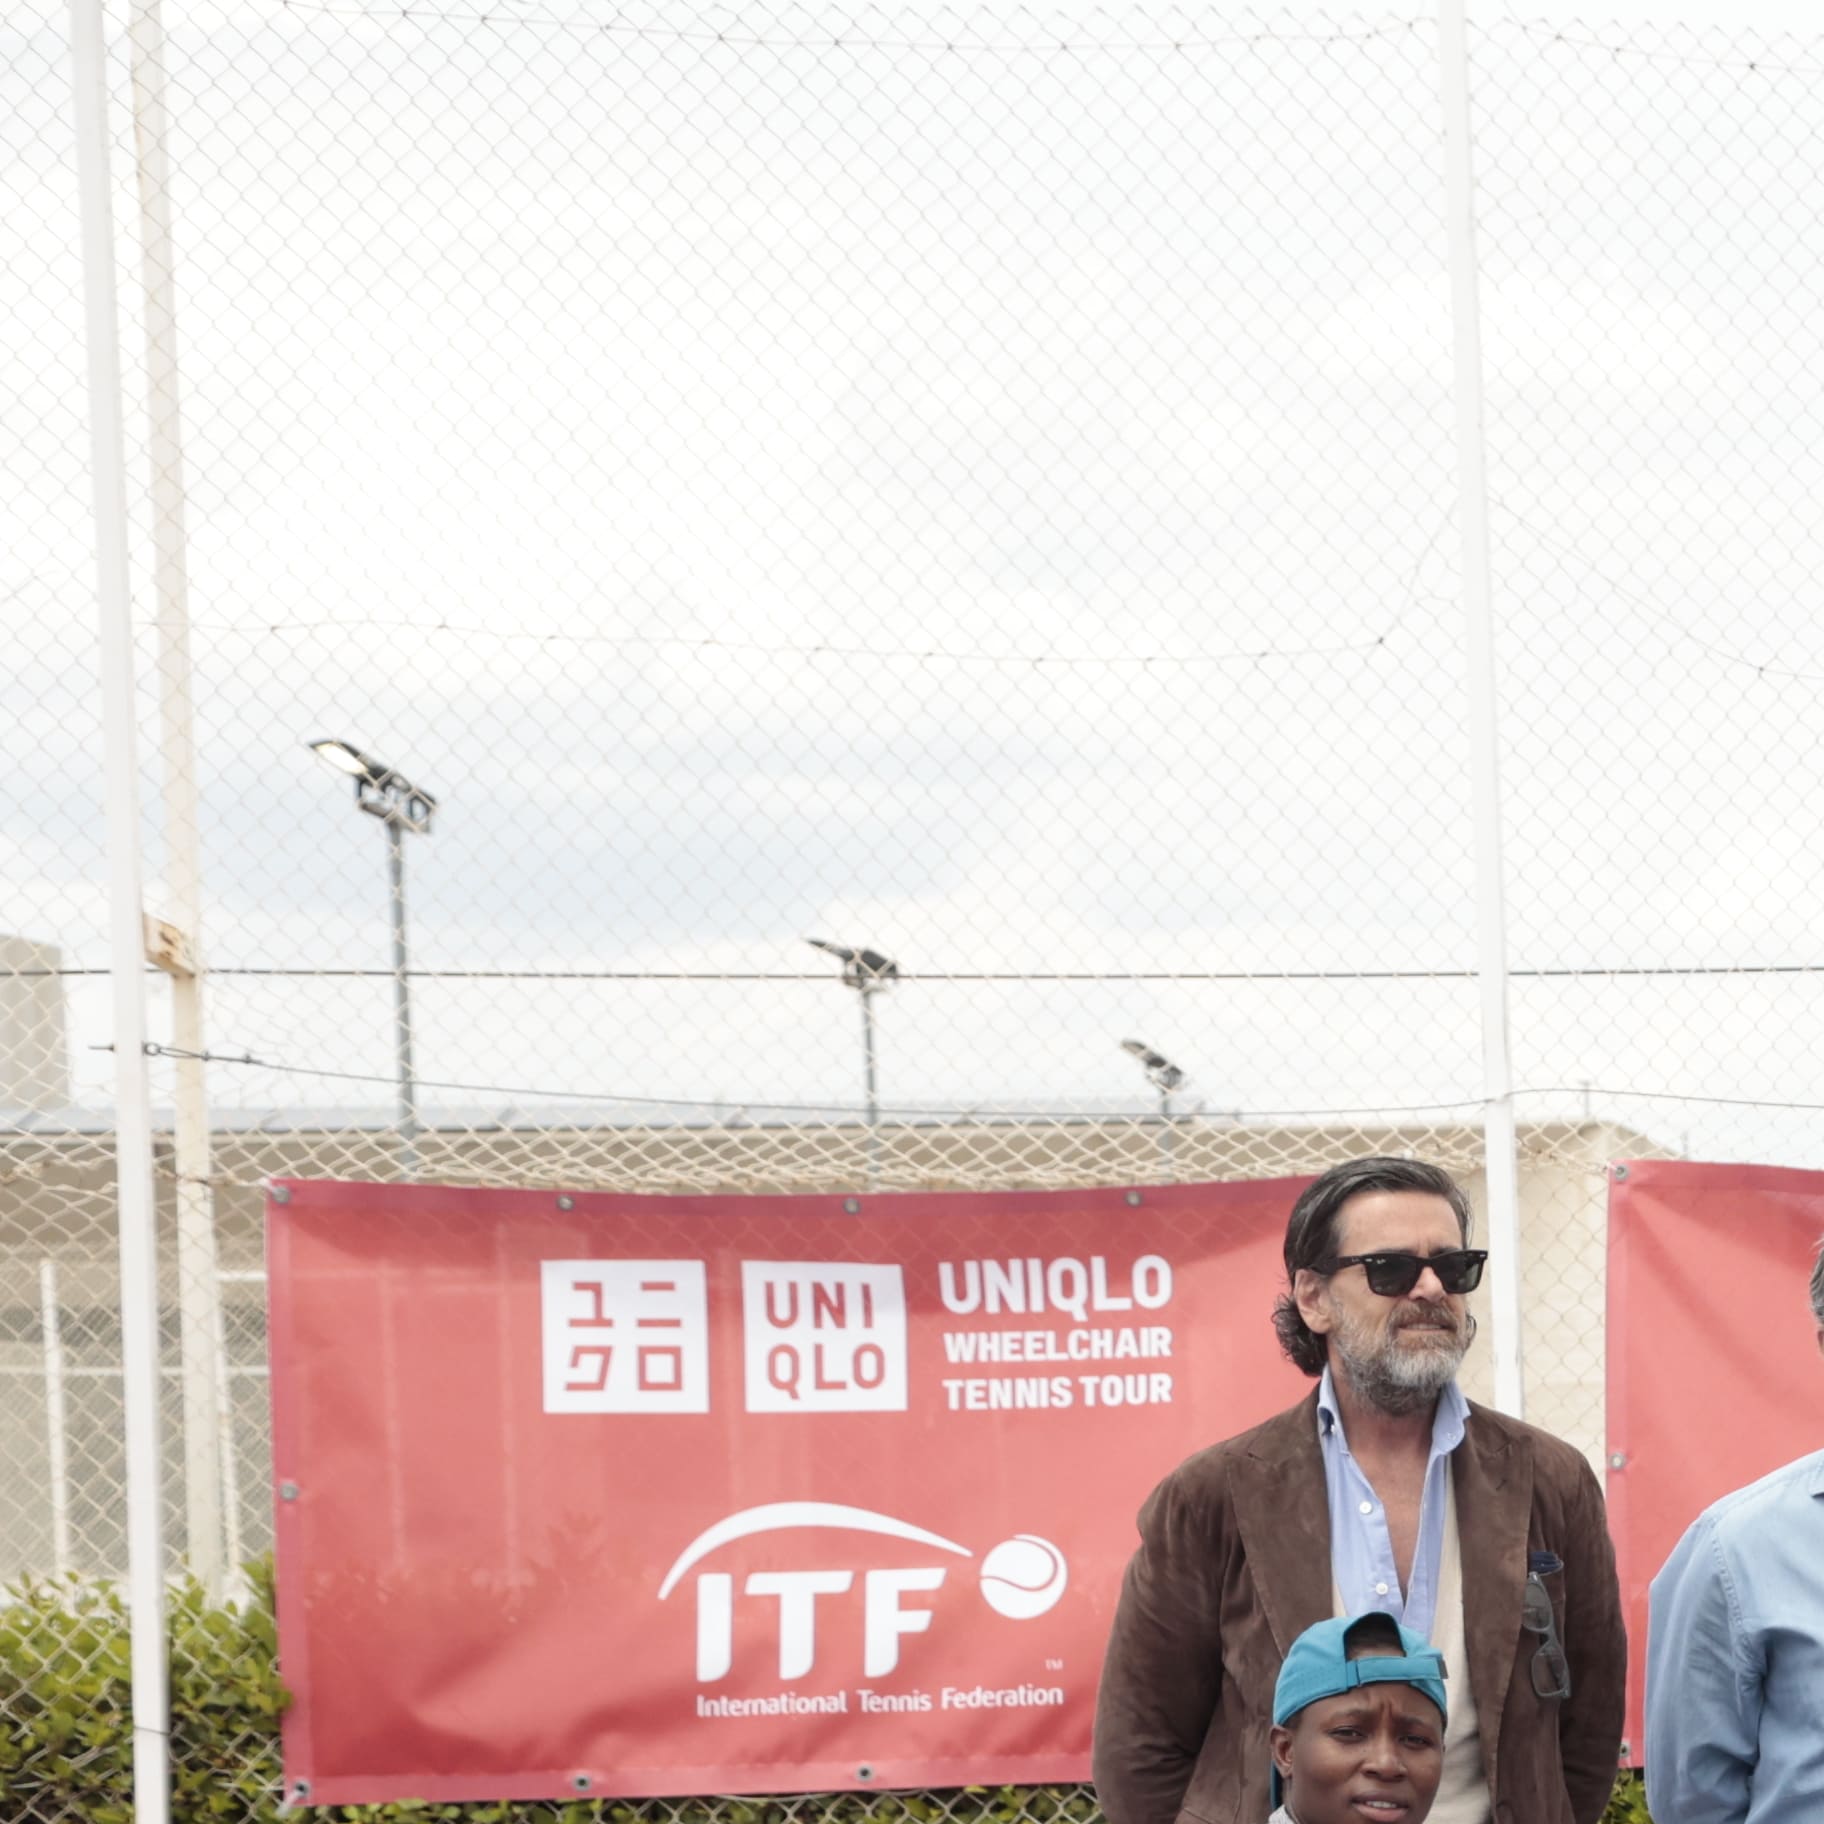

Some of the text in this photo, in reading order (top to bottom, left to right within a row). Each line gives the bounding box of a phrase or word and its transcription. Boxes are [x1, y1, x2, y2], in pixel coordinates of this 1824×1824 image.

[763, 1280, 873, 1329] UNI
[938, 1254, 1173, 1322] UNIQLO
[943, 1326, 1173, 1363] WHEELCHAIR
[767, 1343, 886, 1400] QLO
[942, 1372, 1173, 1410] TENNIS TOUR
[696, 1567, 947, 1682] ITF
[696, 1682, 1063, 1718] International Tennis Federation
